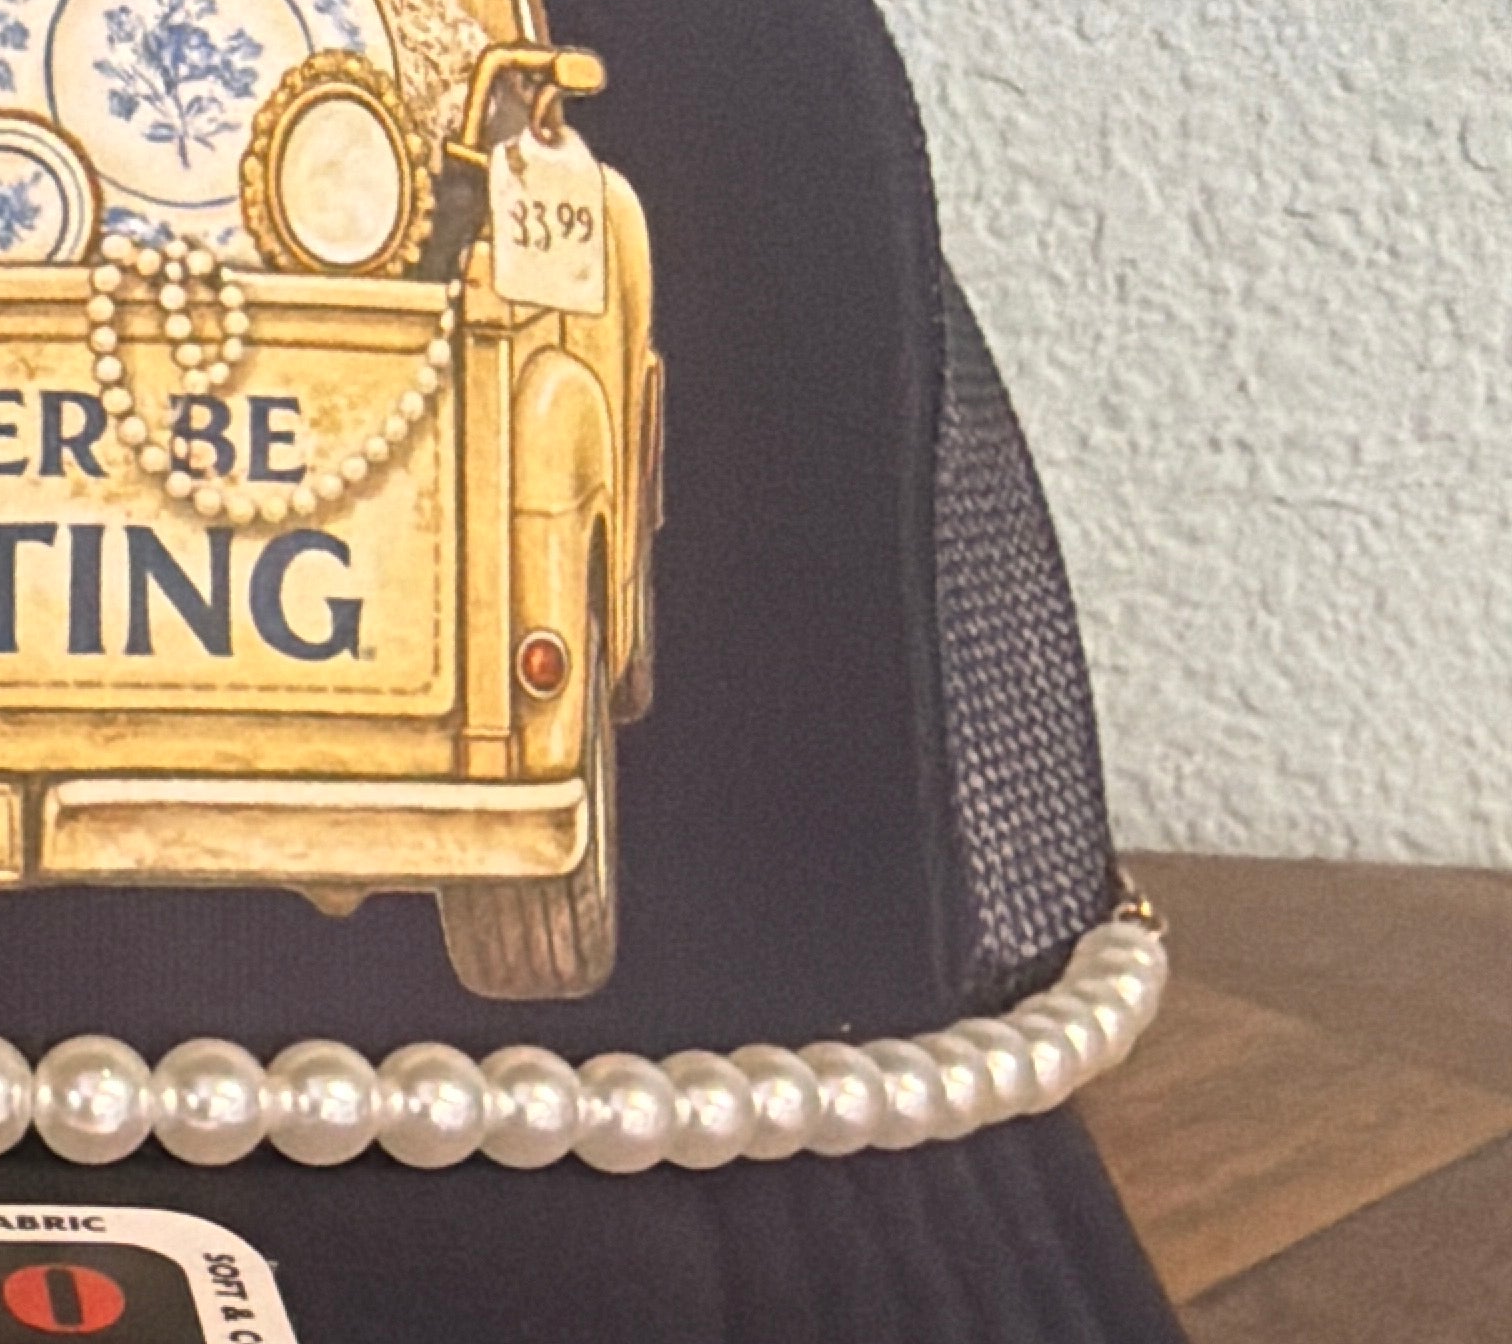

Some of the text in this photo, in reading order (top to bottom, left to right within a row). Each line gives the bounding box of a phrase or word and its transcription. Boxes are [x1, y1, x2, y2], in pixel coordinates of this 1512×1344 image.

[168, 393, 307, 484] BE
[203, 1252, 249, 1302] SOFT
[220, 1305, 256, 1323] &
